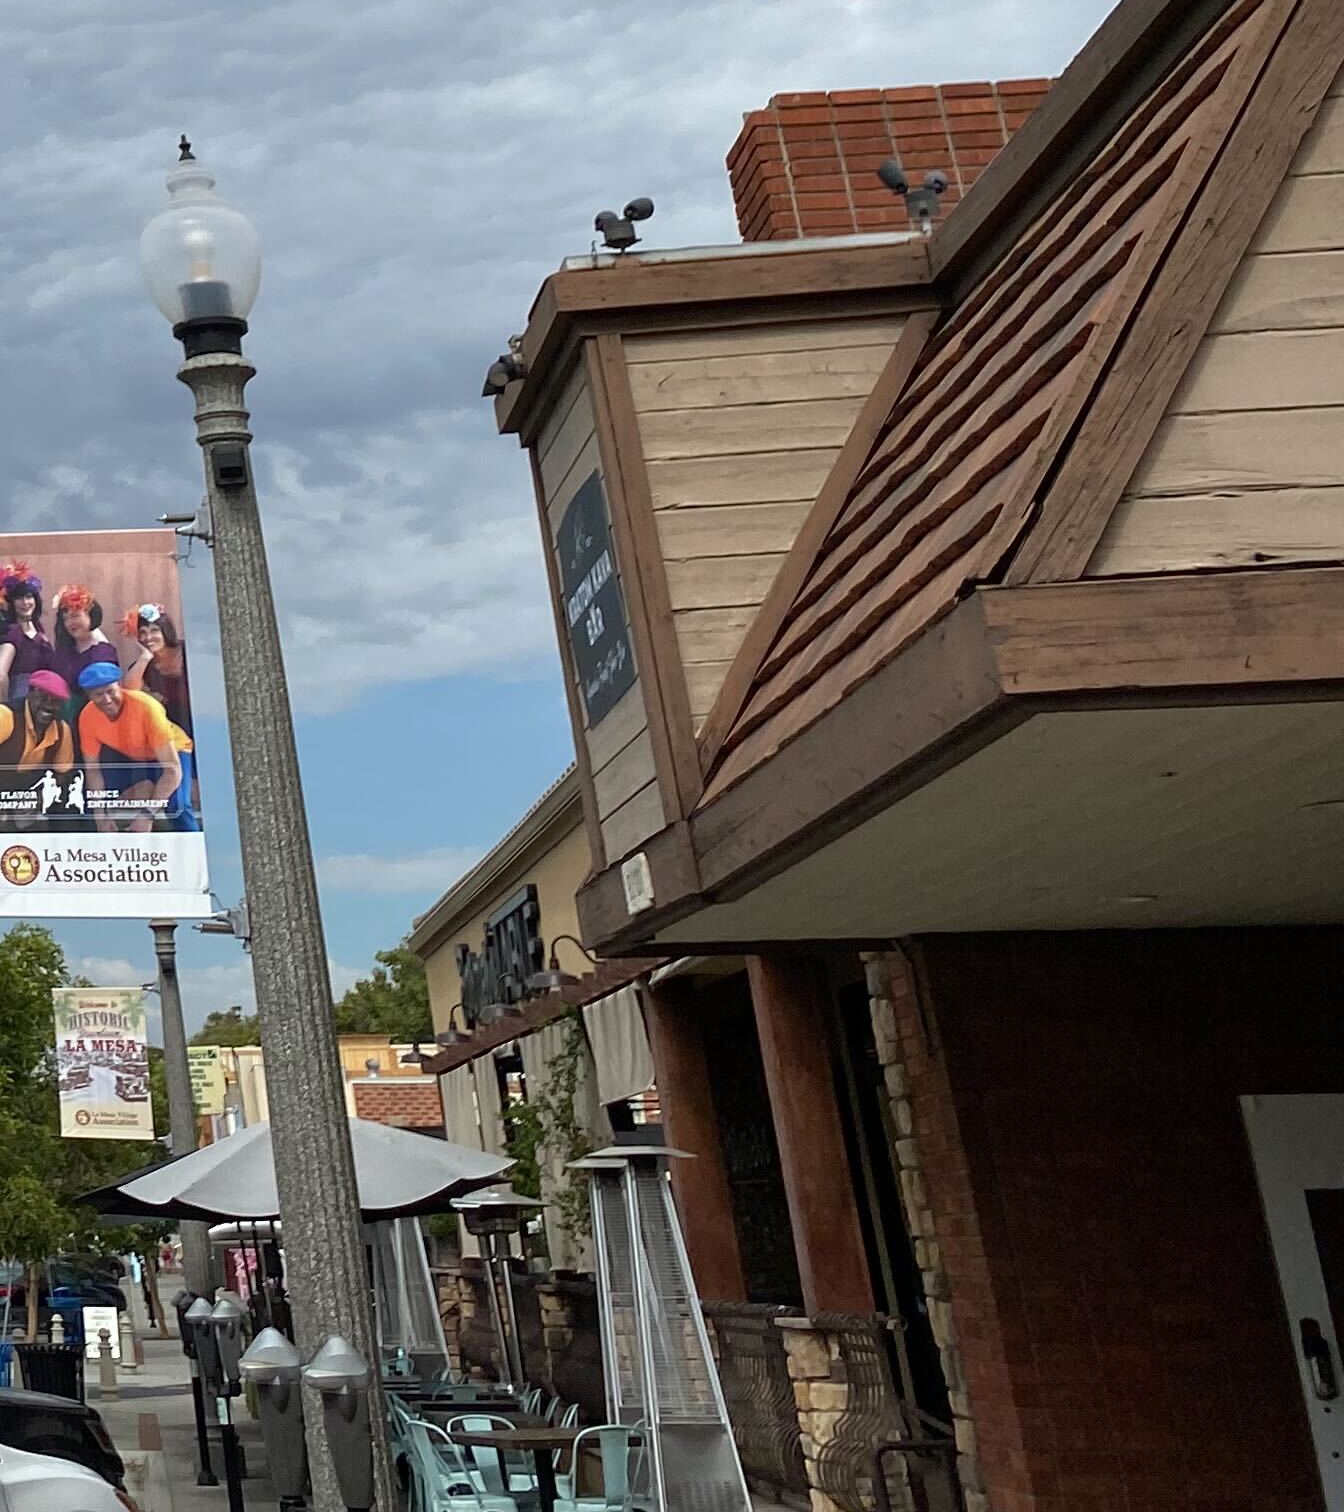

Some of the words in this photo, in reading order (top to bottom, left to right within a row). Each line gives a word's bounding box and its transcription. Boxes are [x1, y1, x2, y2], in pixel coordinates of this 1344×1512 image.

[0, 790, 38, 800] FLAVOR
[86, 790, 119, 799] DANCE
[87, 799, 169, 809] ENTERTAINMENT
[44, 848, 61, 863] La
[66, 848, 108, 863] Mesa
[112, 848, 168, 867] Village
[44, 864, 169, 883] Association
[70, 1012, 130, 1030] HISTORIC
[65, 1040, 86, 1052] LA
[92, 1040, 137, 1052] MESA
